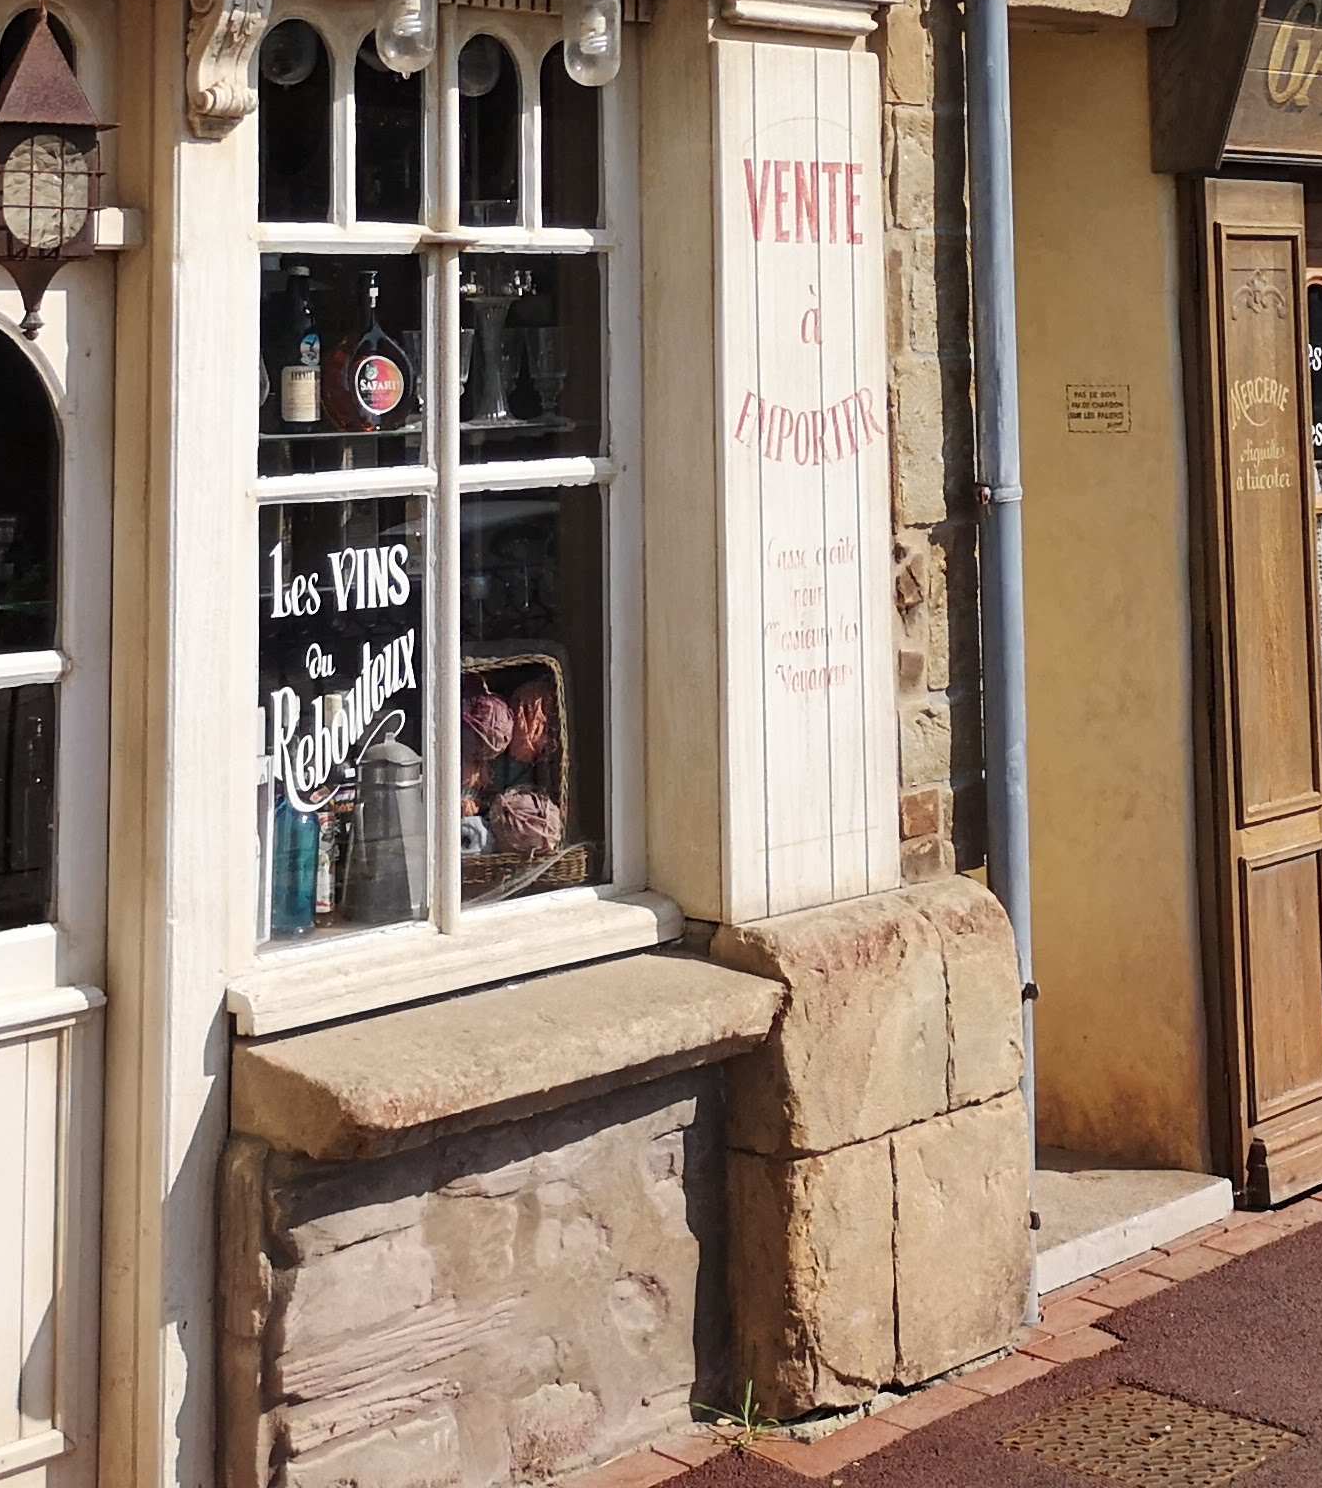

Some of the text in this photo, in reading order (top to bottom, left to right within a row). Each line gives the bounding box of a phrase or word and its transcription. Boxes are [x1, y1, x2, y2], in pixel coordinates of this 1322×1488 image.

[743, 158, 864, 245] VENTE
[801, 284, 823, 345] à
[360, 379, 397, 391] SAFARI
[1230, 376, 1289, 430] MERCERIE
[734, 387, 885, 466] EMPORTER
[328, 544, 410, 612] VINS
[272, 629, 416, 813] Rebouteux
